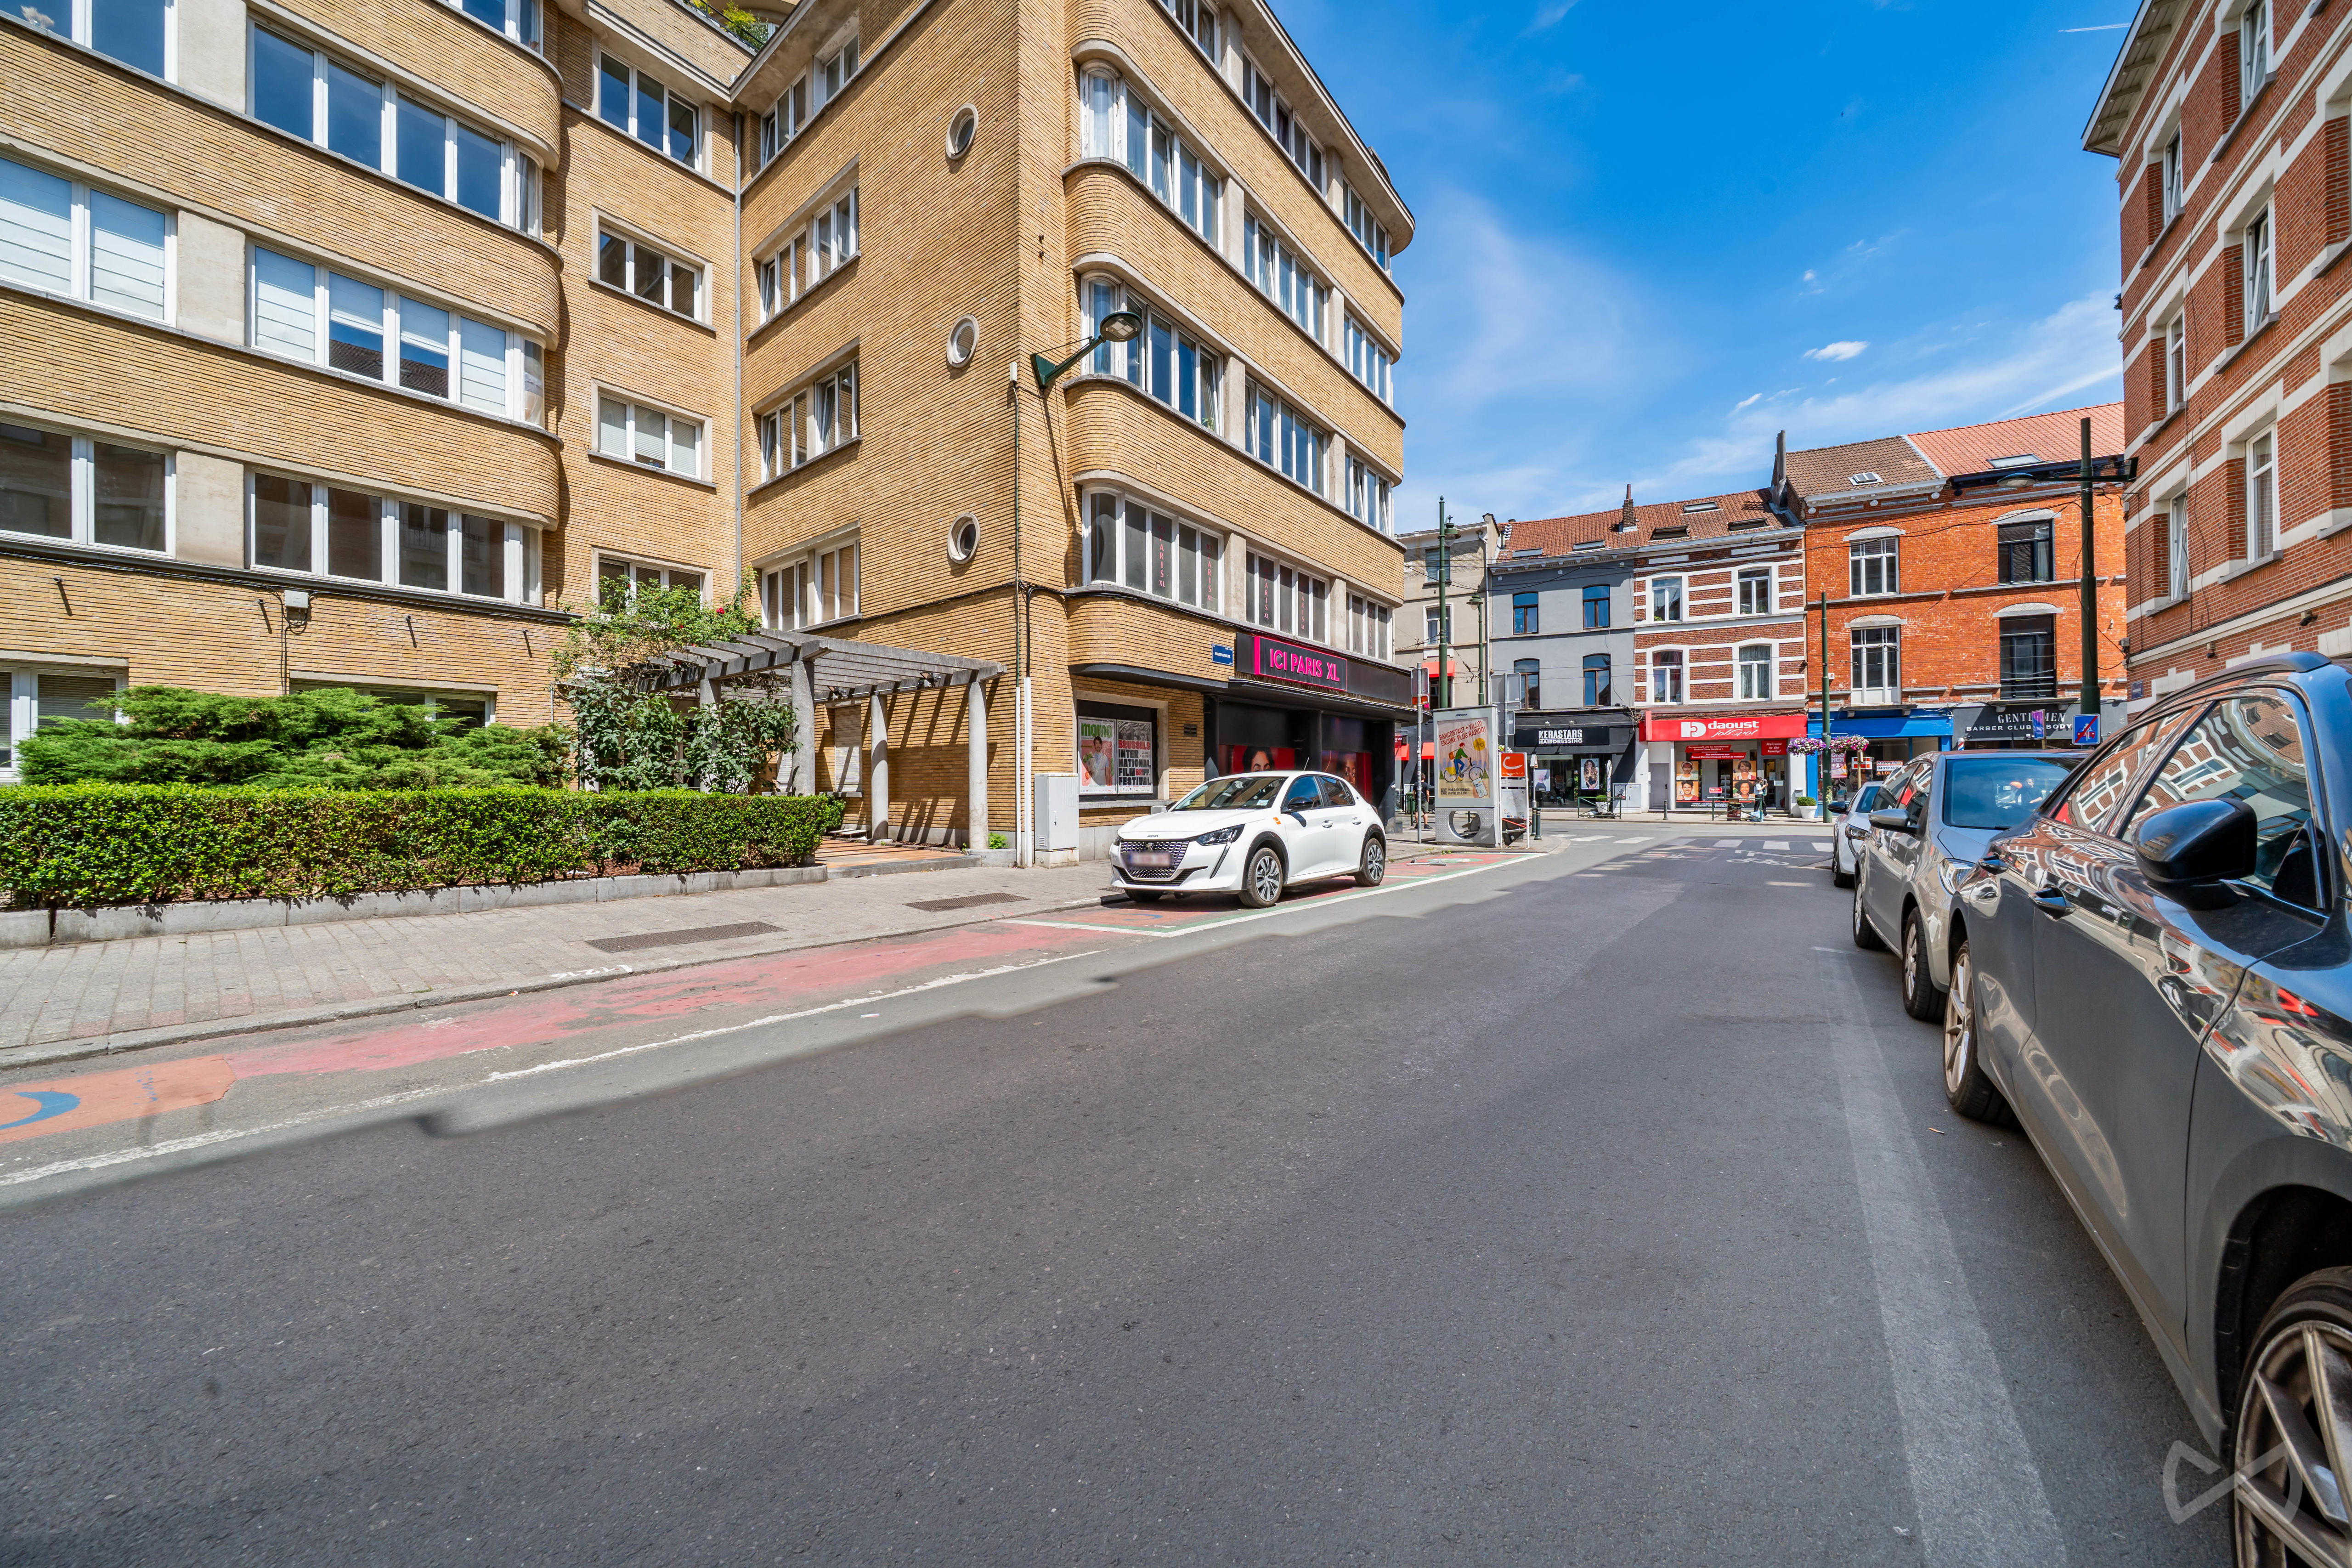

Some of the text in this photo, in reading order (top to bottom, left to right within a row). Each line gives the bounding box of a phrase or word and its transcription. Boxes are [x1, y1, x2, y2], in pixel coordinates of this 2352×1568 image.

[1270, 648, 1340, 681] ICI PARIS XL
[1708, 721, 1759, 729] daoust
[1439, 726, 1465, 740] BANCONTACT
[1469, 720, 1483, 730] VILLO!
[1538, 729, 1583, 739] KERASTARS
[1441, 726, 1486, 746] ENCORE PLUS RAPIDO!
[1119, 740, 1150, 750] BRUSSELS
[1119, 749, 1139, 758] INTER
[1119, 759, 1151, 768] NATIONAL
[1119, 768, 1135, 776] FILM
[1119, 777, 1151, 785] FESTIVAL
